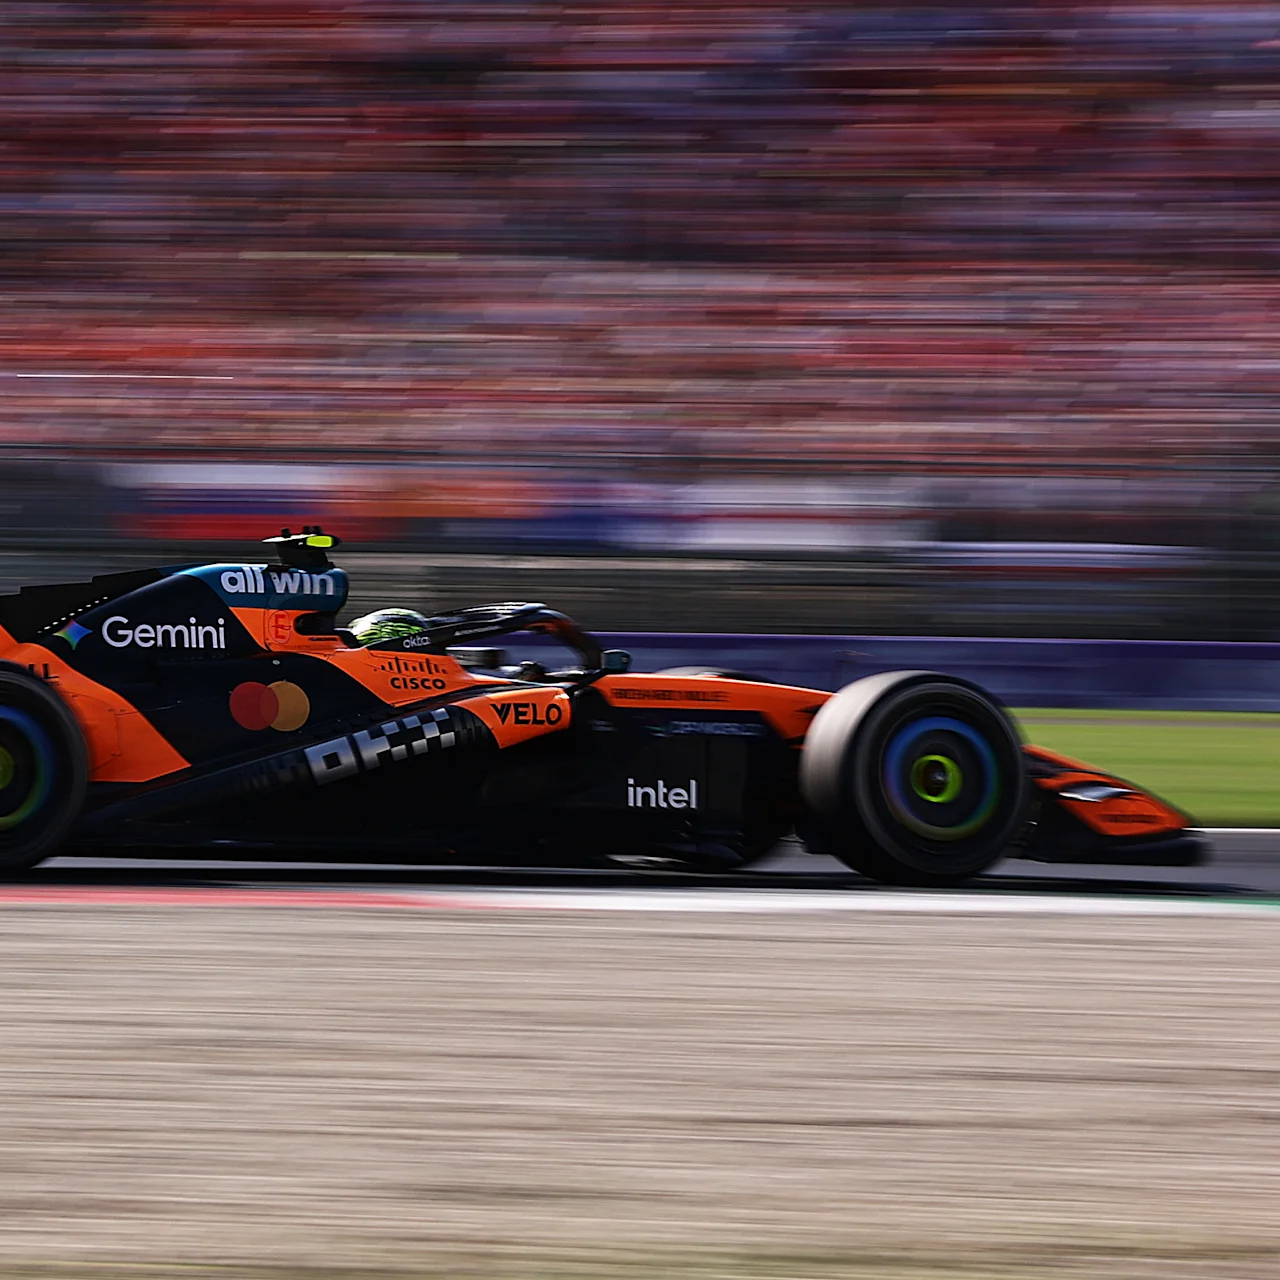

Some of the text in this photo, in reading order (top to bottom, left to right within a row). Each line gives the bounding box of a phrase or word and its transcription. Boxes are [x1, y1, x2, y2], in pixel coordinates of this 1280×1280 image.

[220, 566, 265, 594] all
[102, 615, 226, 649] Gemini
[402, 636, 432, 649] okta
[391, 677, 446, 690] CISCO
[490, 703, 562, 726] VELO
[627, 777, 698, 809] intel
